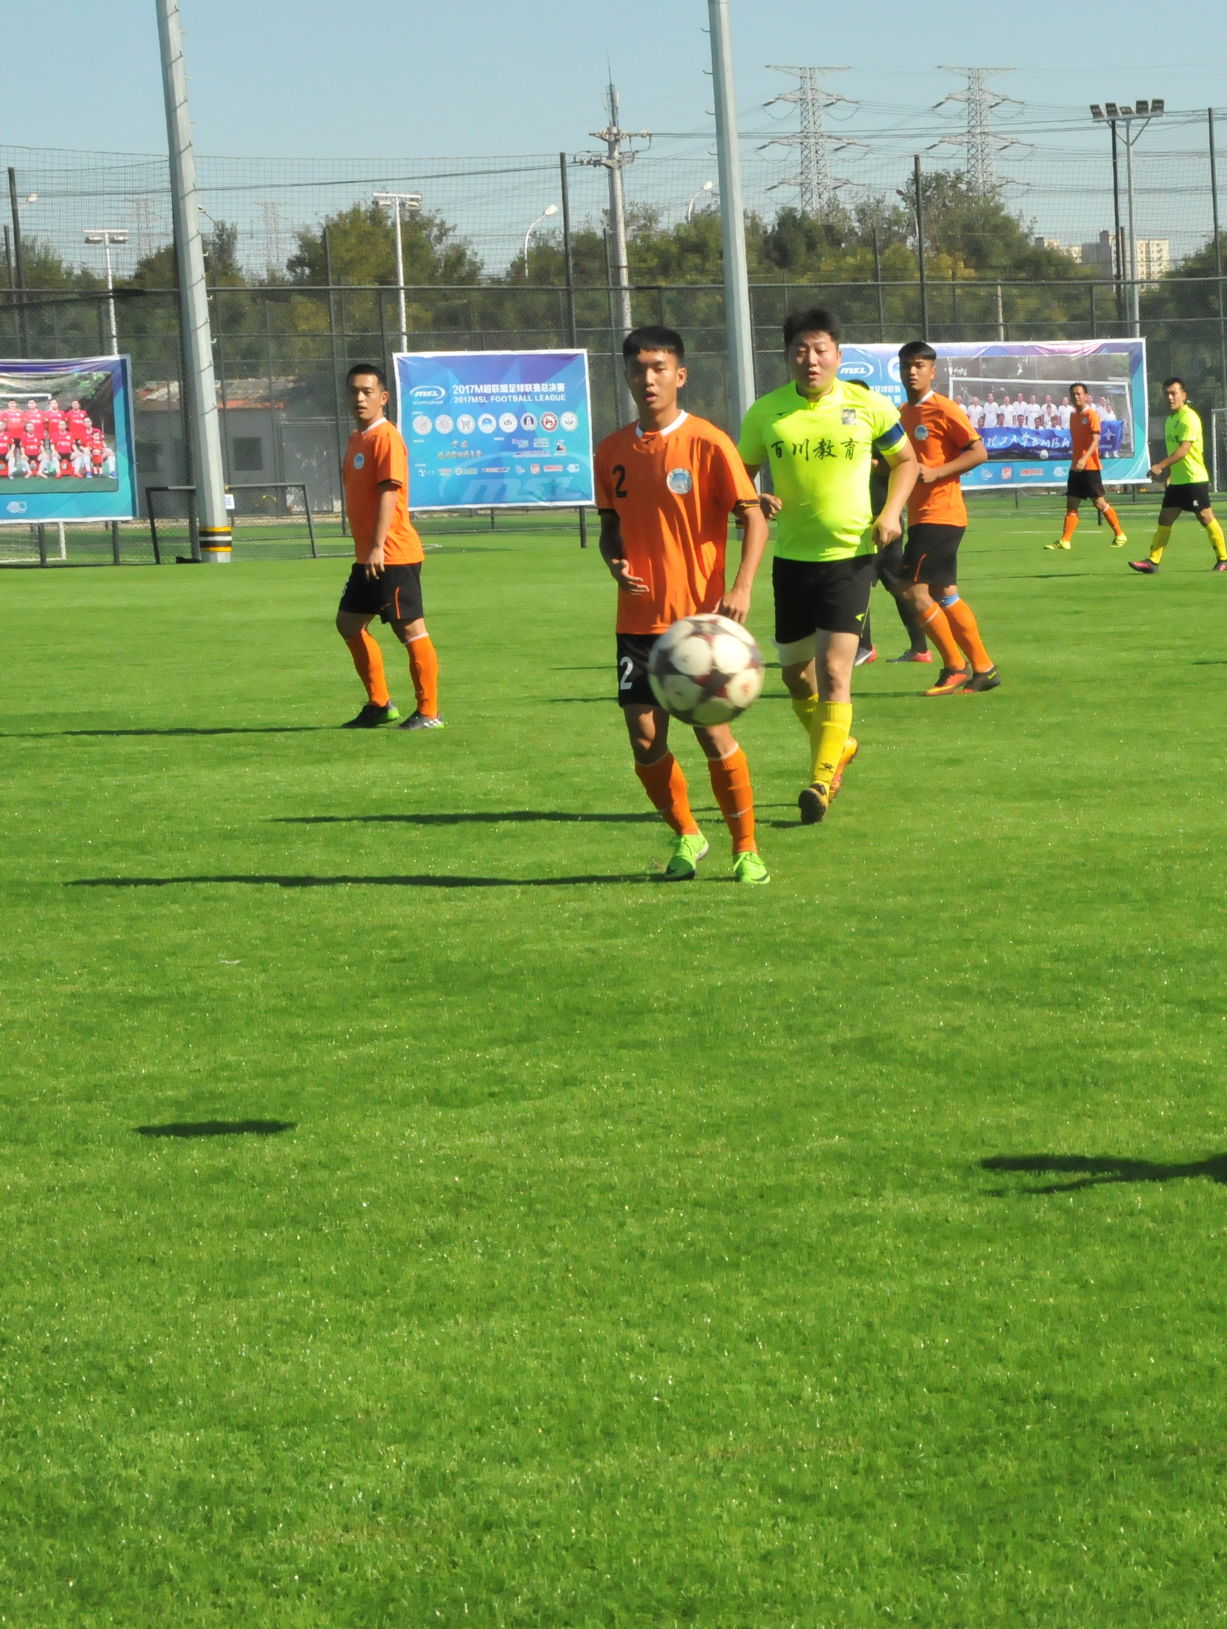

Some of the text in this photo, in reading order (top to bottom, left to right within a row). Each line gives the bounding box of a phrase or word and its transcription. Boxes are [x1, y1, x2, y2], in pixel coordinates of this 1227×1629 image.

[454, 394, 566, 404] 2017MSL FOOTBALL LEAGUE
[770, 437, 860, 462] 百川教育
[611, 464, 628, 498] 2
[619, 656, 634, 691] 2
